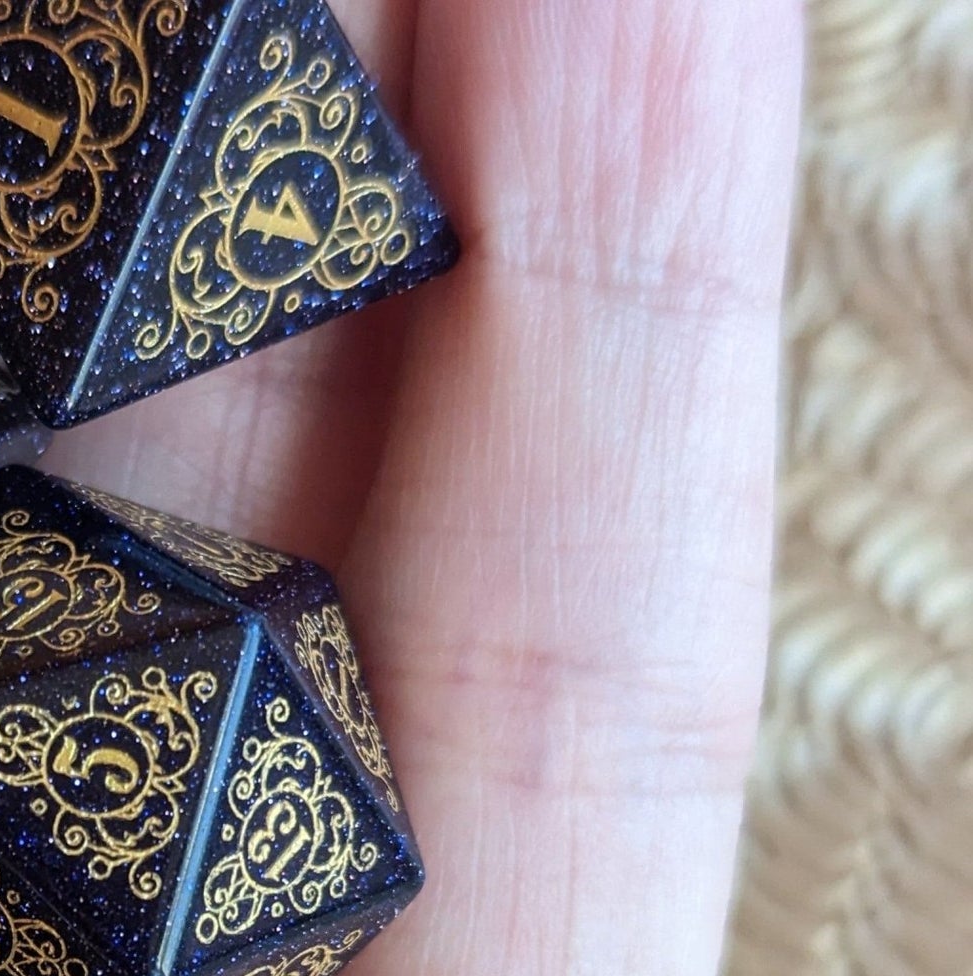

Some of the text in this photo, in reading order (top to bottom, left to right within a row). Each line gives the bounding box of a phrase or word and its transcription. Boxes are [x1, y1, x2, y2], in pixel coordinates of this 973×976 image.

[239, 178, 319, 249] 4
[52, 736, 140, 794] 5
[248, 801, 312, 882] 13
